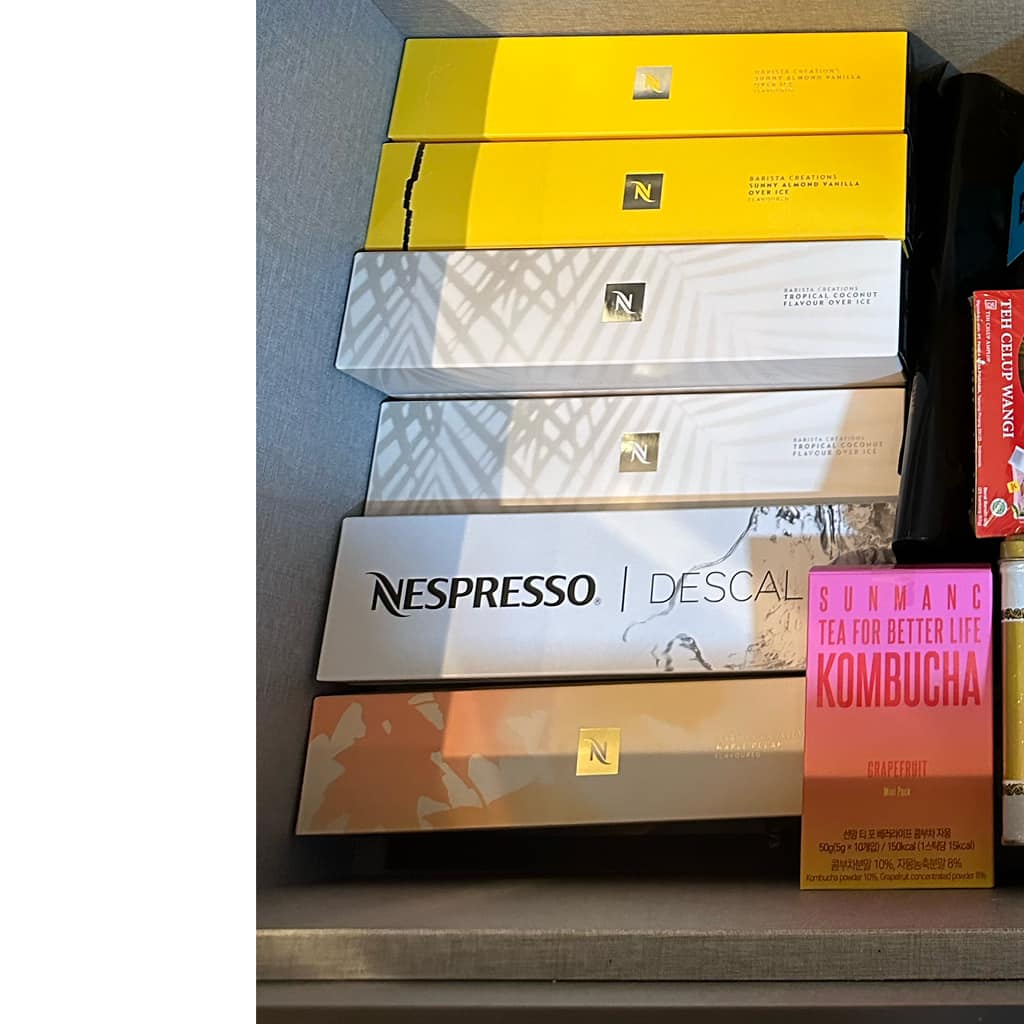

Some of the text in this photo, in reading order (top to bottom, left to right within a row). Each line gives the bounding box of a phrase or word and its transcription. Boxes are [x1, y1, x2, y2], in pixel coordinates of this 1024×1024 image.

[1000, 298, 1015, 438] TEH CELUP WANGI
[840, 441, 883, 449] COCONUT
[365, 569, 804, 618] NESPRESSO DESCAL
[819, 617, 981, 646] TEA FOR BETTER LIFE
[816, 650, 981, 708] KOMBUCHA
[867, 760, 928, 778] GRAPEFRUIT
[897, 786, 911, 797] Pack
